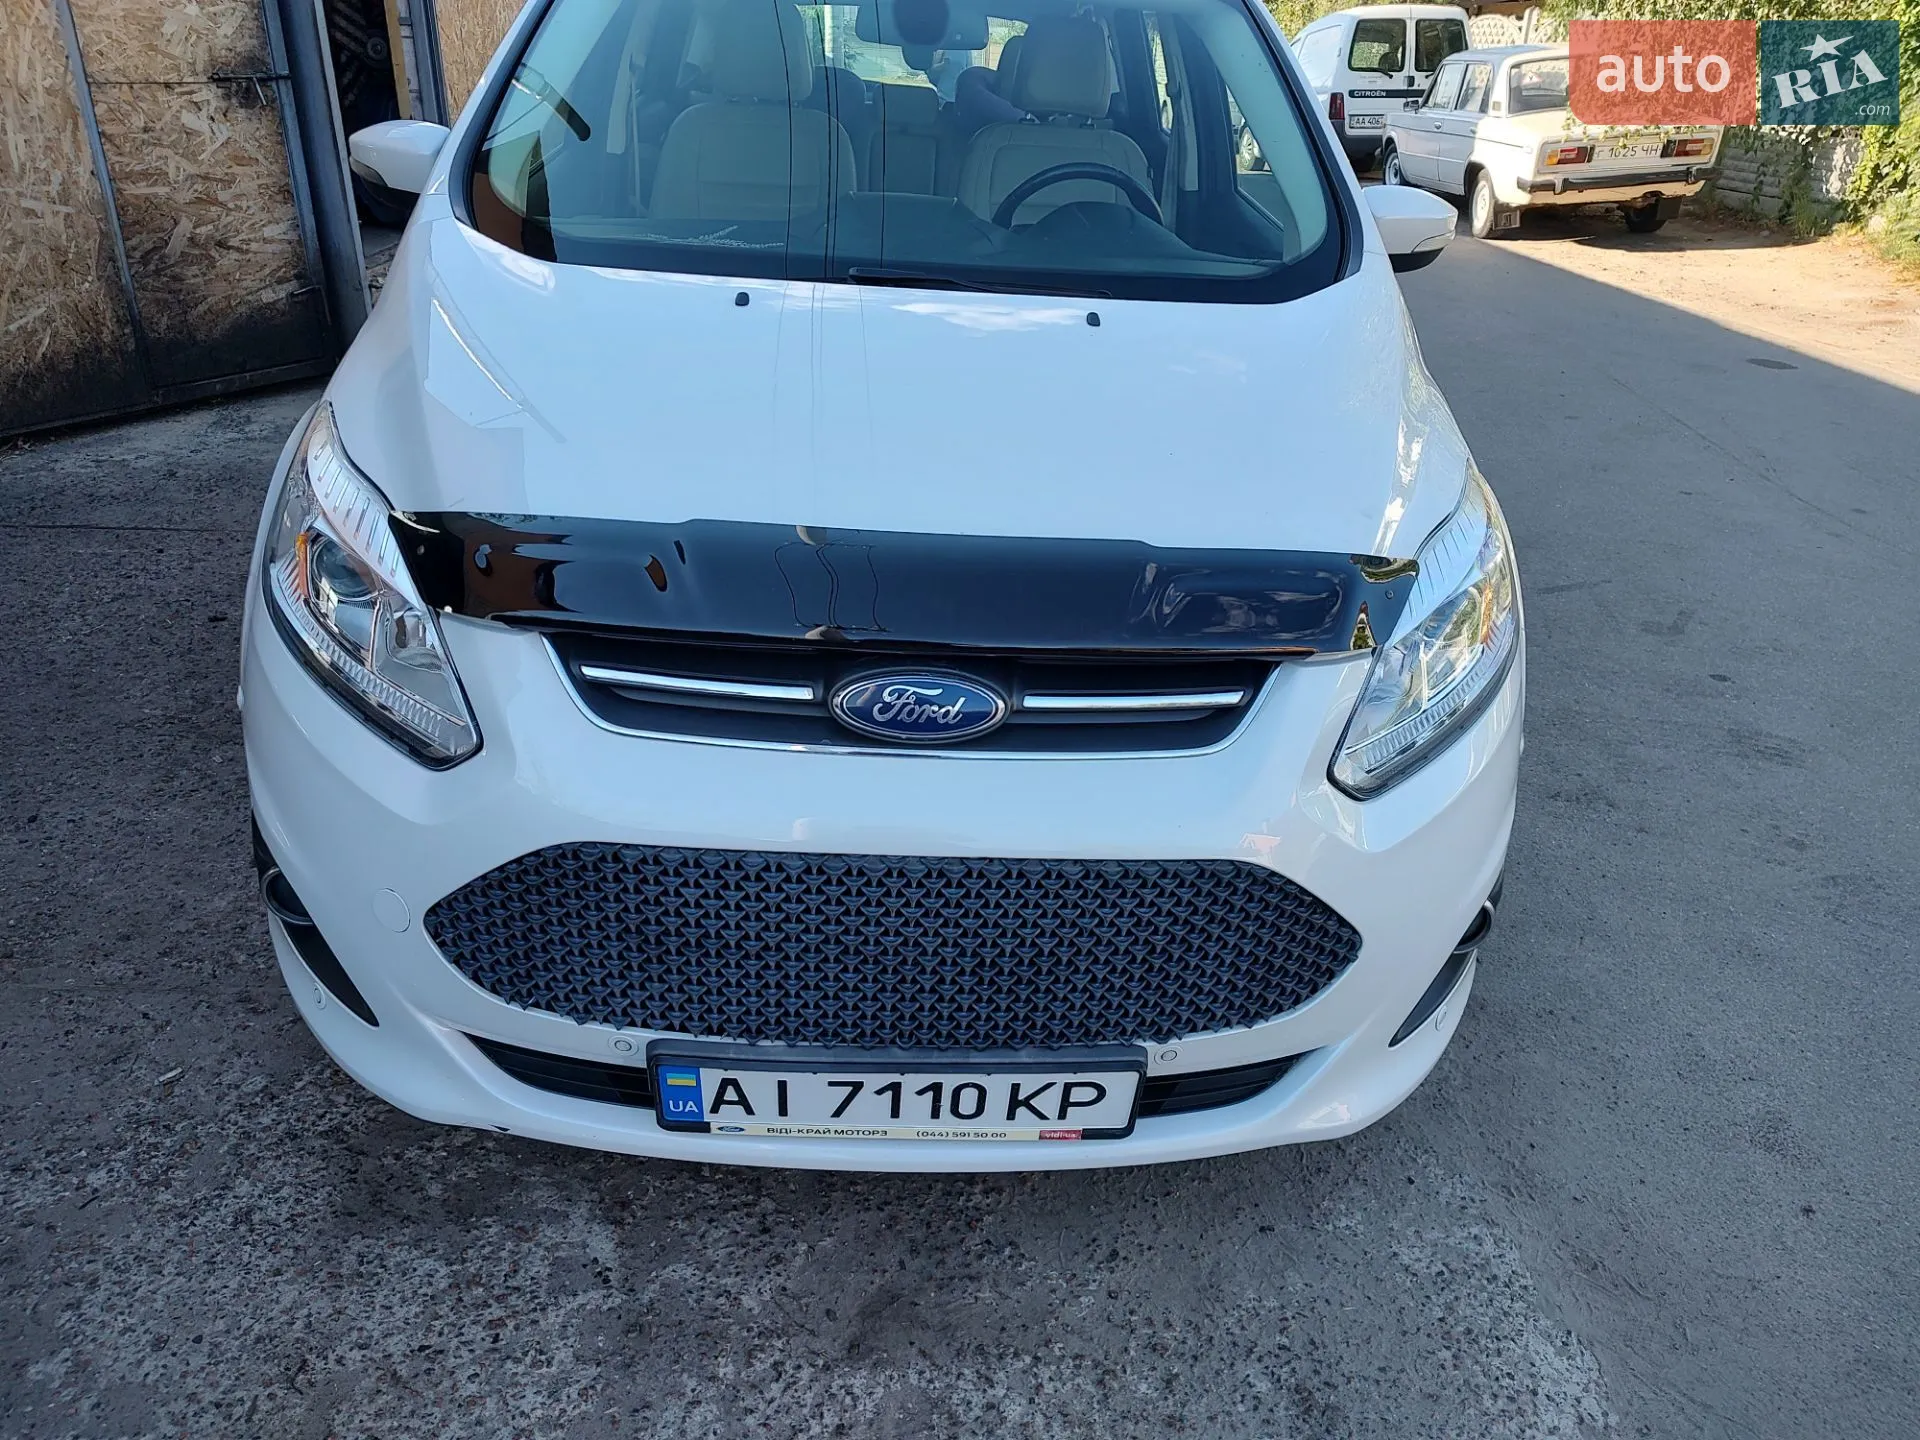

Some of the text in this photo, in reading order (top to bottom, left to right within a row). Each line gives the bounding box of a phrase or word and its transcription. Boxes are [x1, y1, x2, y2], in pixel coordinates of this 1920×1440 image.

[1355, 117, 1366, 125] AA
[1608, 146, 1639, 158] 1025
[872, 685, 967, 724] Ford
[669, 1100, 699, 1113] UA
[827, 1080, 988, 1120] 7110
[1005, 1081, 1107, 1121] KP
[916, 1130, 949, 1138] (044)
